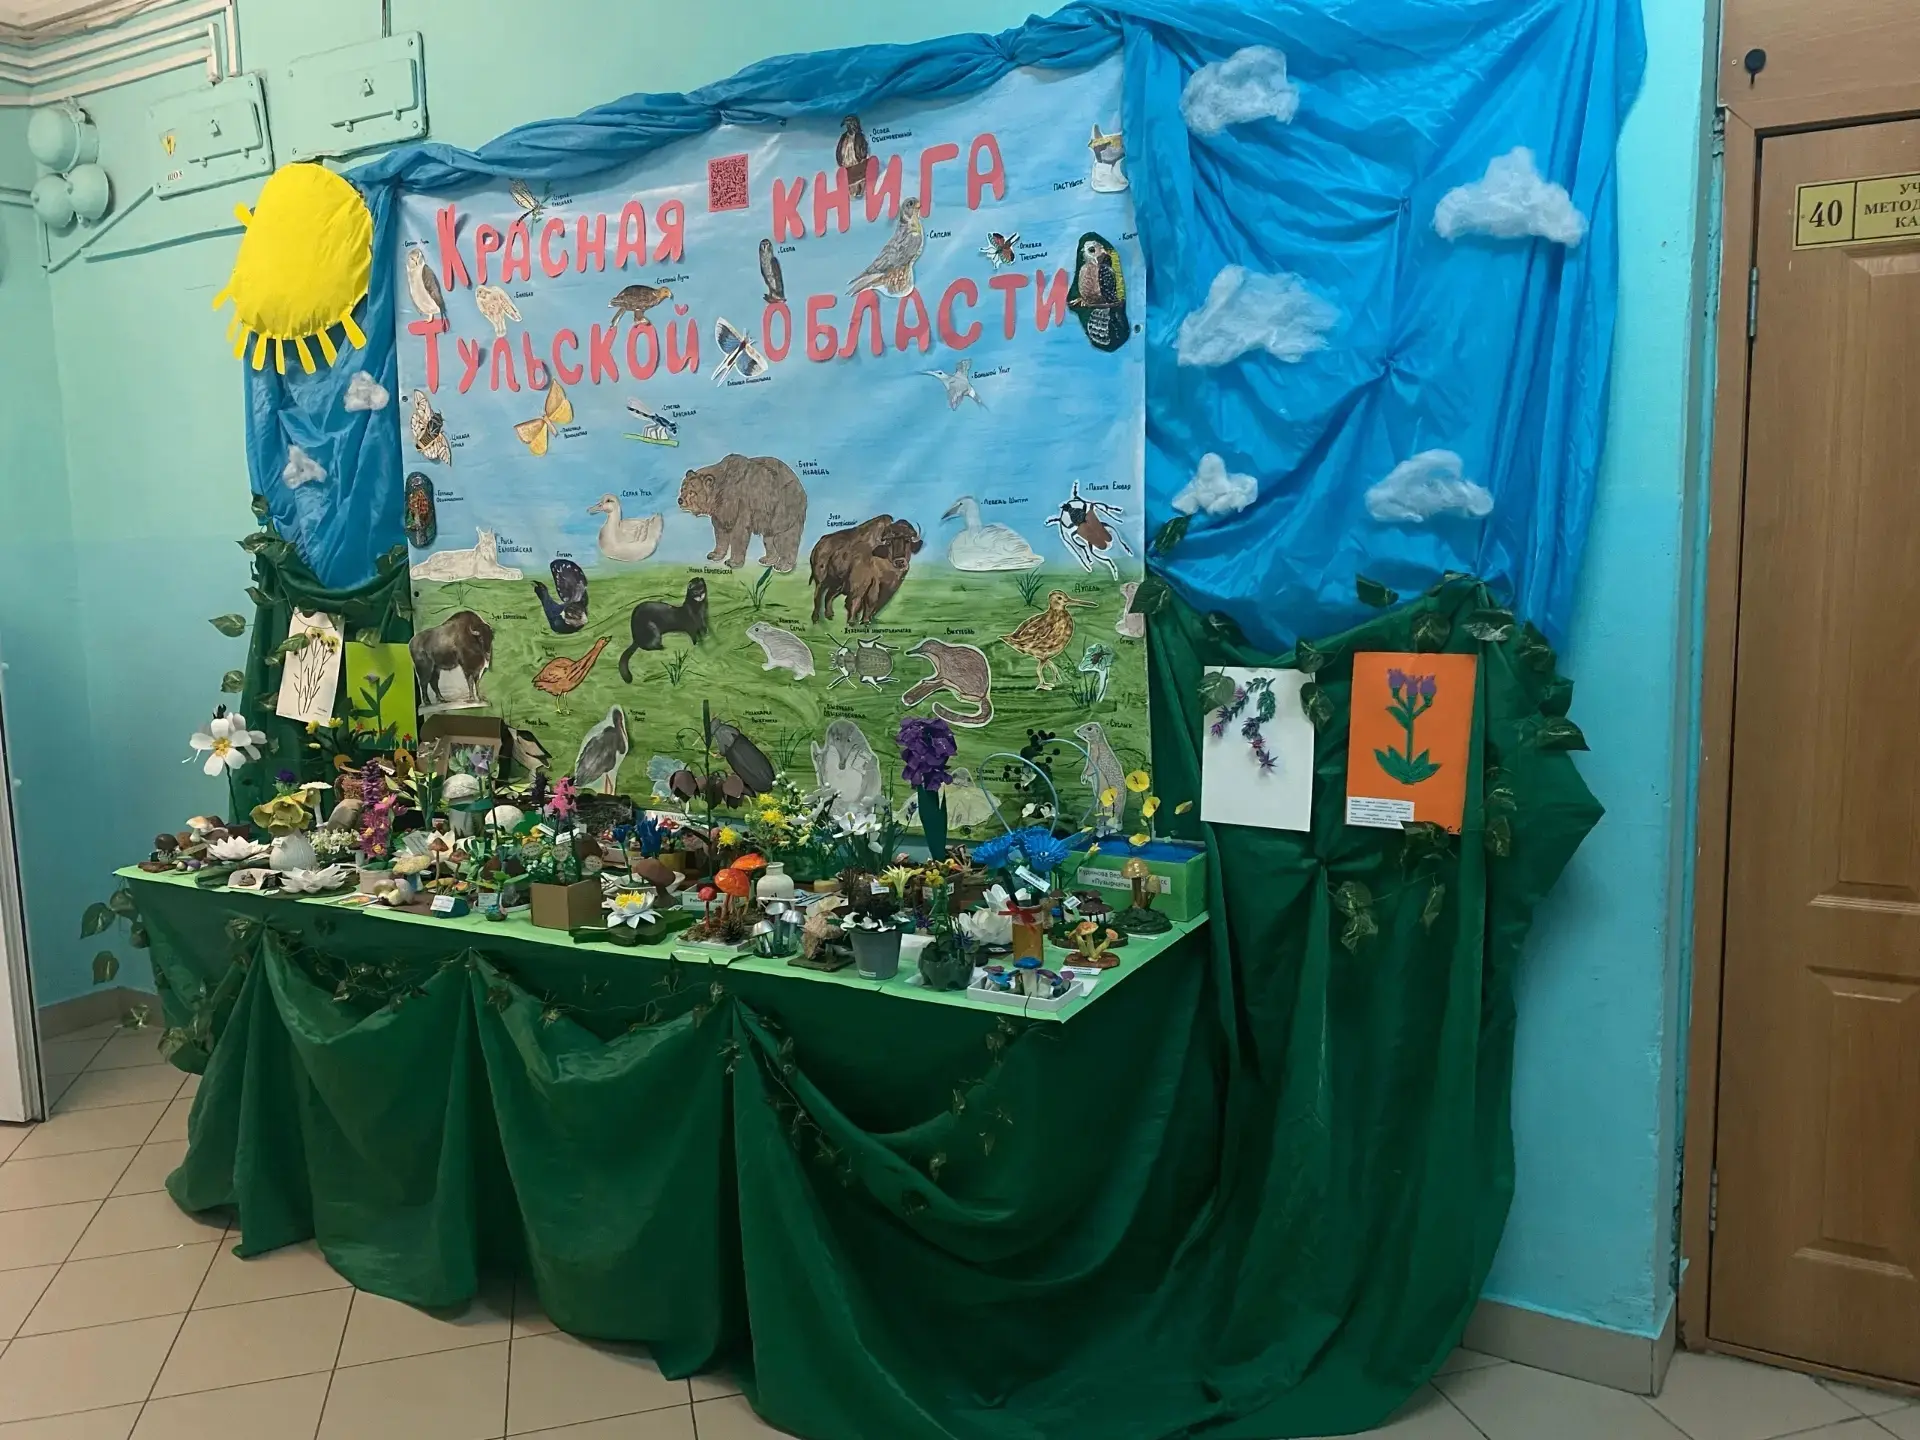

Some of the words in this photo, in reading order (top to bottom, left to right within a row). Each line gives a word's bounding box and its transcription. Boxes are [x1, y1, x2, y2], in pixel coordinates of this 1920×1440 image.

[436, 200, 685, 291] КРАСНАЯ
[772, 133, 1006, 243] КНИГА
[1808, 199, 1843, 228] 40
[407, 303, 700, 395] ТУЛЬСКОЙ
[762, 268, 1070, 362] ОБЛАСТИ
